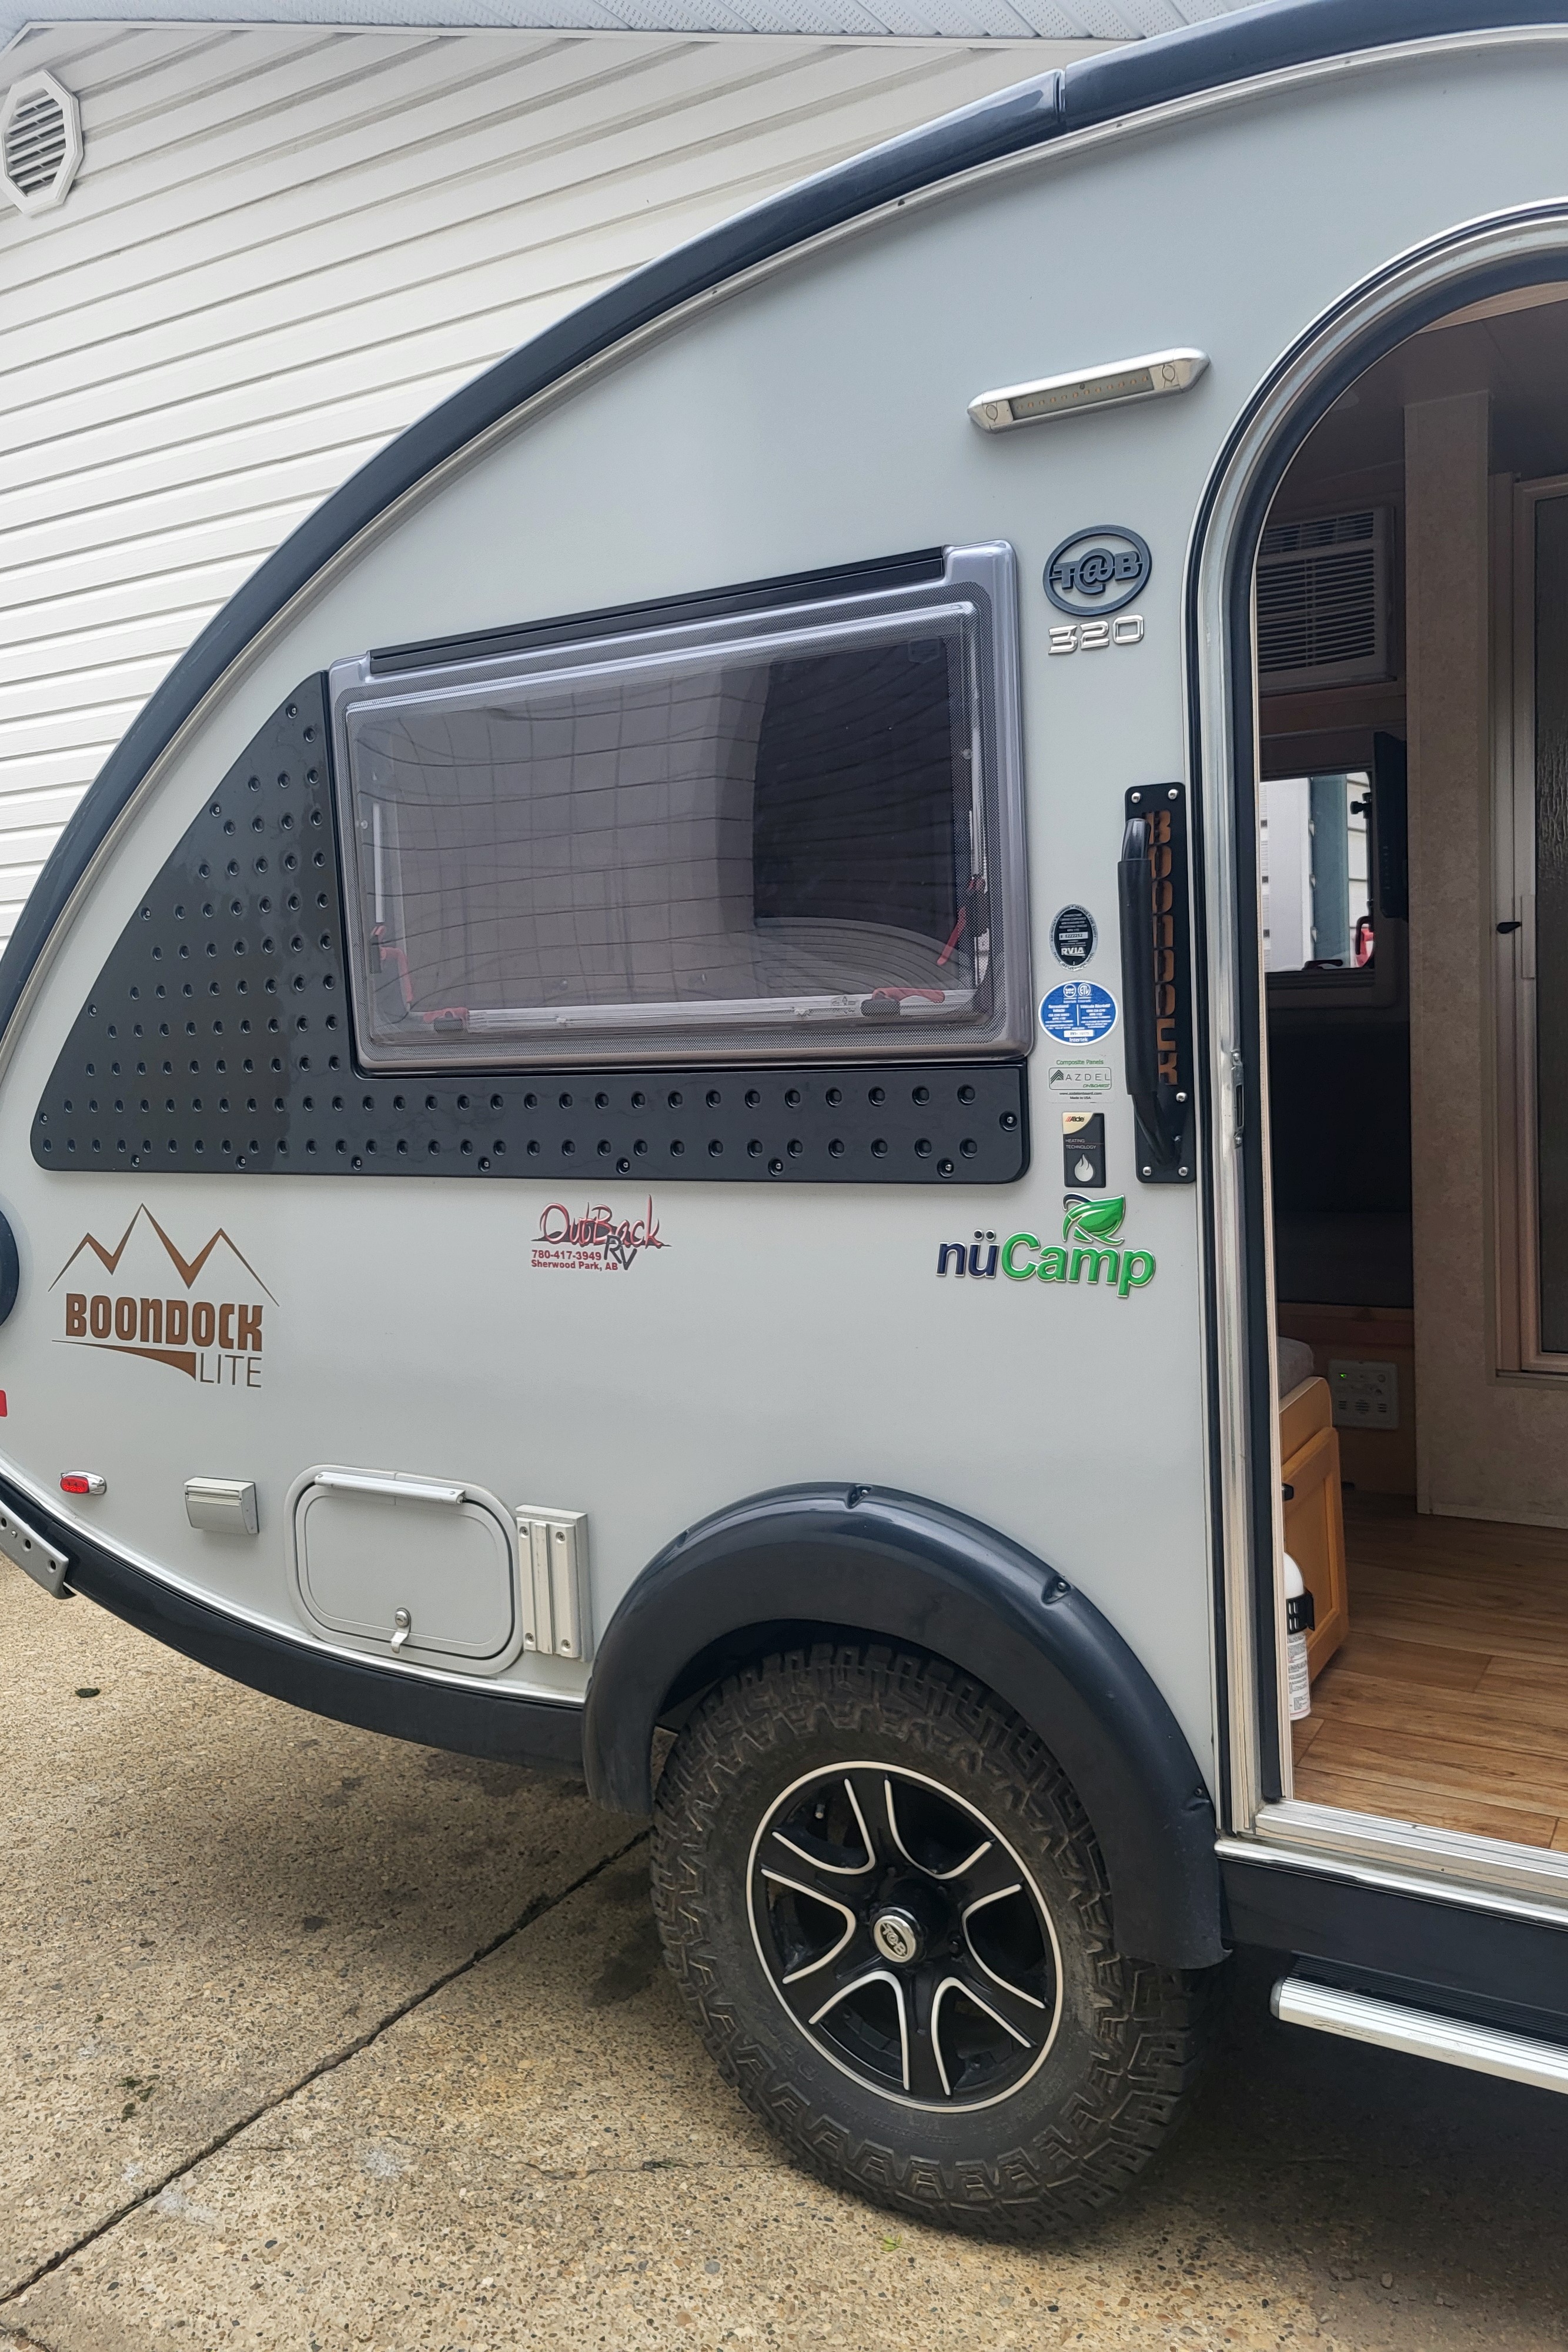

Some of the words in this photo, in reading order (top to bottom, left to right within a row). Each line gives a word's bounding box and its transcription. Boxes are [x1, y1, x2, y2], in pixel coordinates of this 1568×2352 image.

[1053, 547, 1141, 595] T@B
[1048, 614, 1144, 655] 320
[1061, 947, 1085, 956] RVIA
[1065, 1073, 1111, 1081] AZDEL
[531, 1250, 602, 1261] 780-417-3949
[531, 1259, 576, 1269] Sherwood
[579, 1261, 603, 1271] Park,
[605, 1262, 618, 1271] AB
[603, 1235, 638, 1271] RV
[935, 1229, 1156, 1298] nüCamp
[65, 1292, 264, 1352] BOONDOCK
[200, 1352, 262, 1388] LITE
